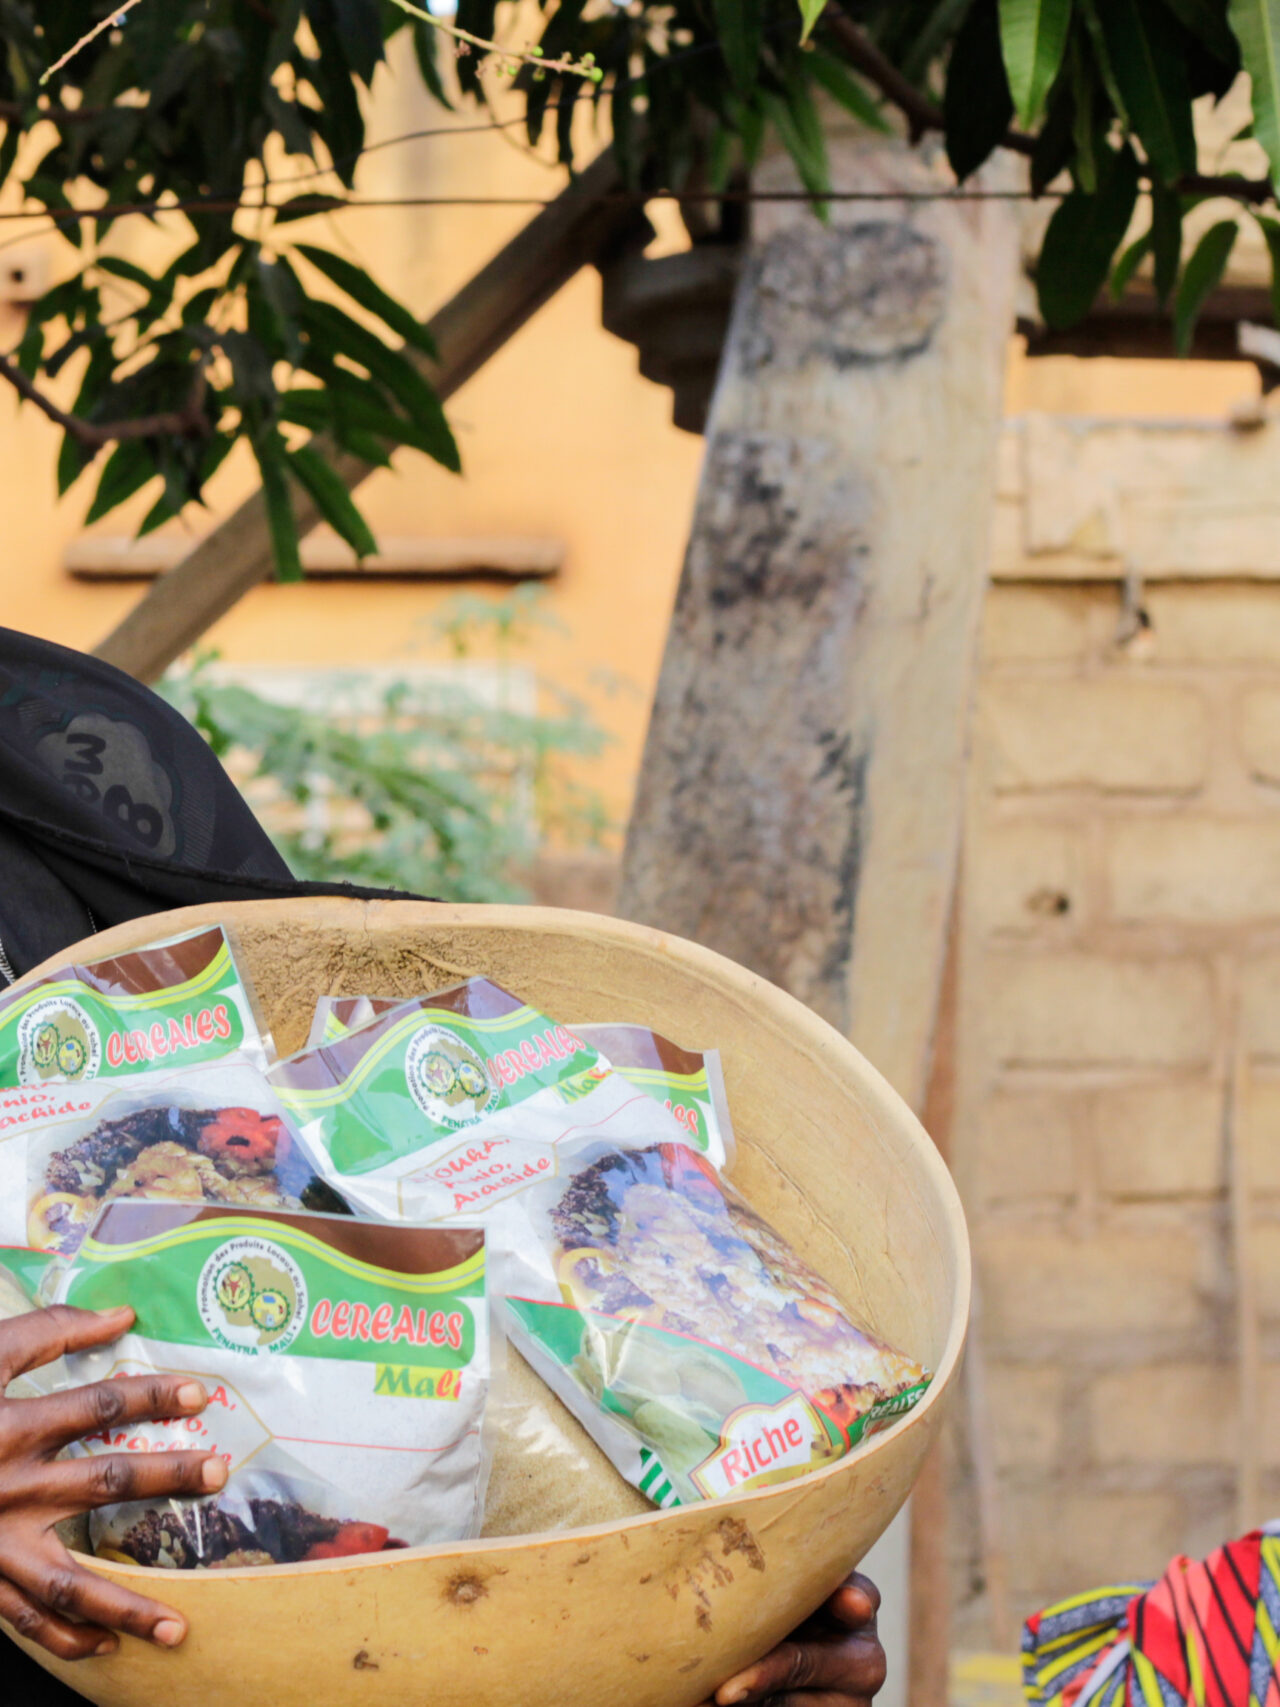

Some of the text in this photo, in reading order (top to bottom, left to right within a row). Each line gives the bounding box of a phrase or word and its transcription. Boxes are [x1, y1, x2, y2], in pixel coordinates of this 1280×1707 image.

[102, 784, 164, 848] 8
[106, 1003, 232, 1068] CEREALES
[201, 1262, 216, 1314] Promotion
[214, 1249, 229, 1263] des
[229, 1239, 265, 1251] Produits
[266, 1246, 294, 1273] Locaux
[296, 1291, 305, 1321] Sahel
[211, 1326, 295, 1356] FENATRA MALI
[311, 1298, 464, 1349] CEREALES
[375, 1364, 462, 1401] Mali
[720, 1417, 804, 1488] Riche
